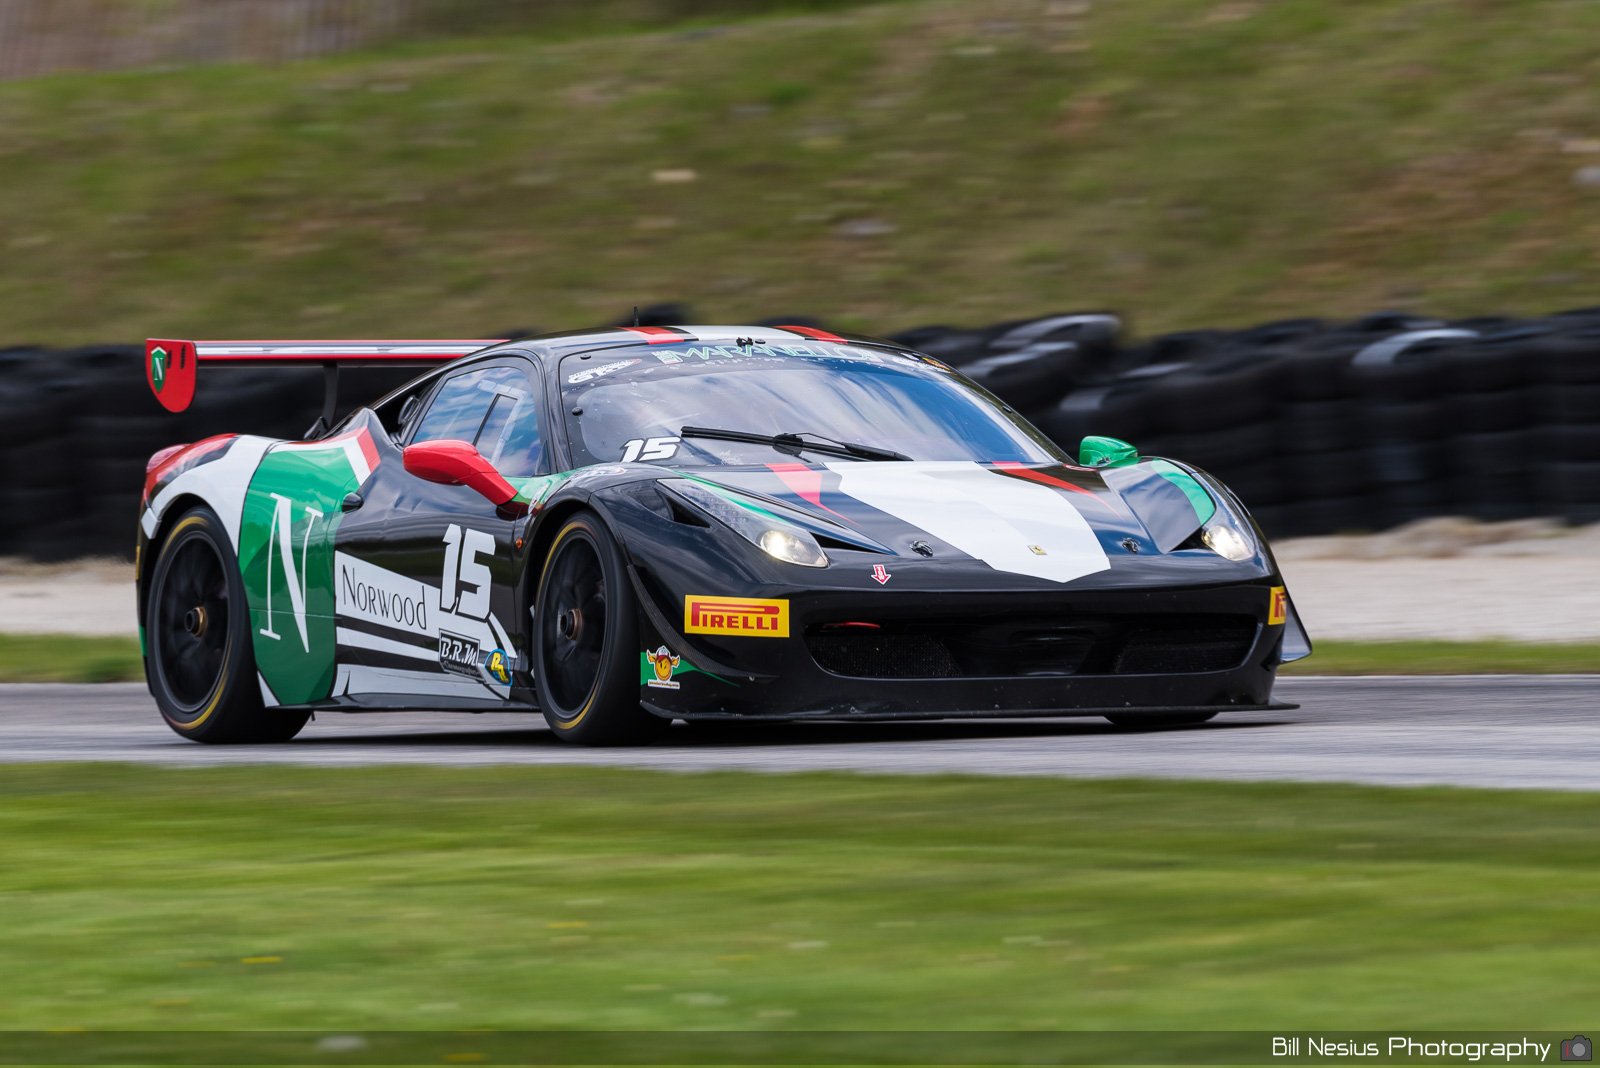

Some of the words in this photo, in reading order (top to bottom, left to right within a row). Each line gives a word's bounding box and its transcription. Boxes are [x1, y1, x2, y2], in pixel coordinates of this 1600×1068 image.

[621, 436, 681, 463] 15
[259, 492, 324, 654] N
[441, 523, 496, 620] 15
[691, 602, 780, 630] PIRELLI
